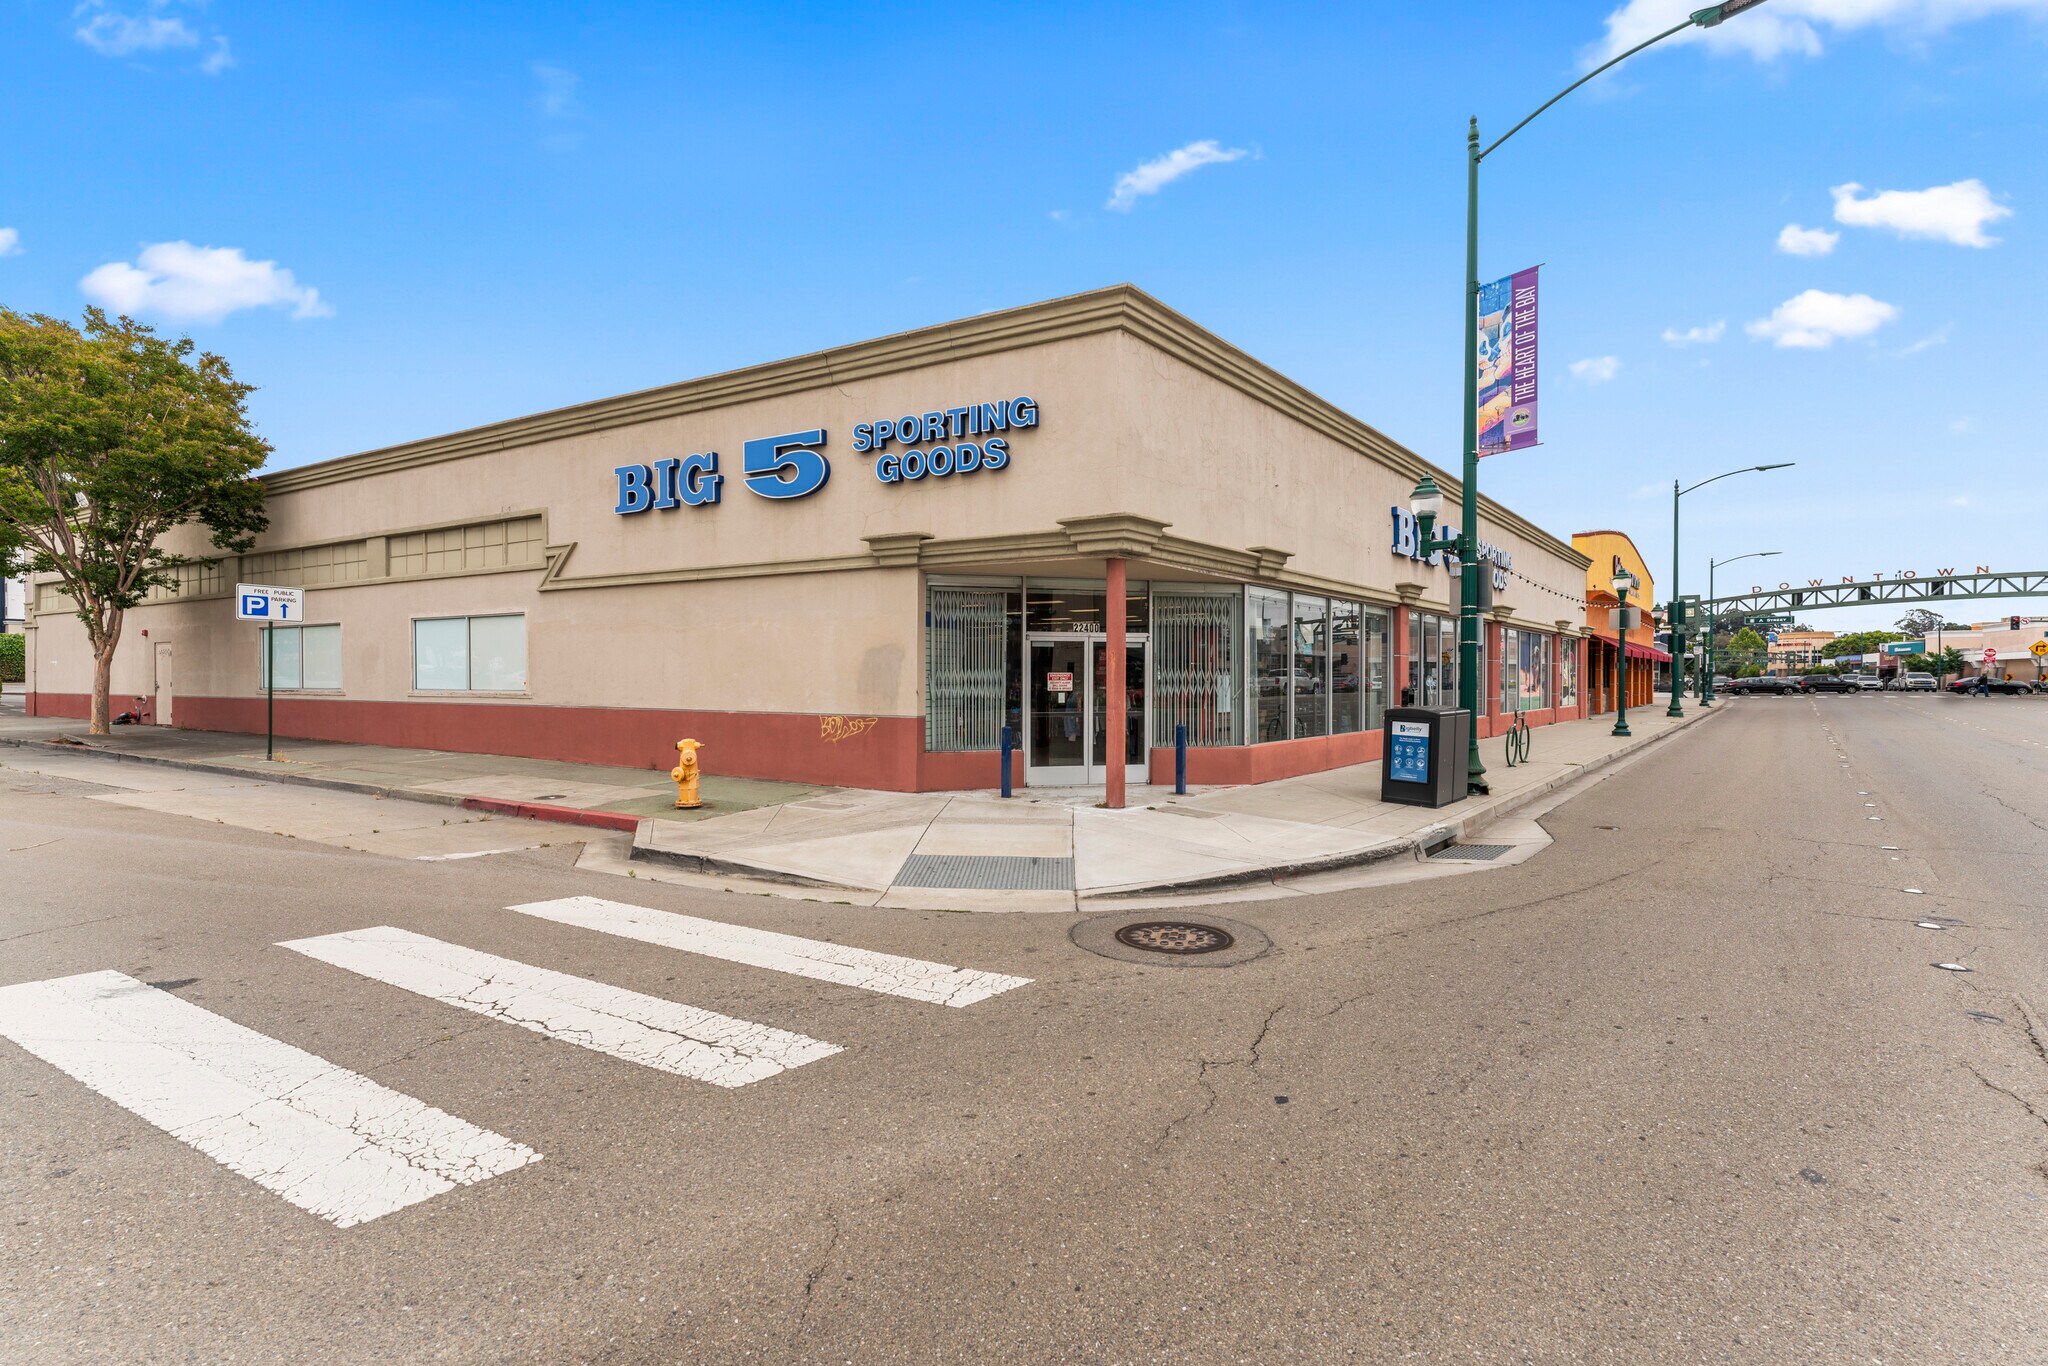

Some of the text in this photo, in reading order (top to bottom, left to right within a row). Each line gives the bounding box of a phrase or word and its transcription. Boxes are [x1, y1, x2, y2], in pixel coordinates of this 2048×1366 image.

[1515, 285, 1535, 402] THE HEART OF THE BAY
[851, 396, 1039, 453] SPORTING
[614, 428, 831, 516] BIG 5
[876, 437, 1010, 483] GOODS
[1752, 565, 1990, 594] DOWNTOWN
[1073, 623, 1099, 632] 22400
